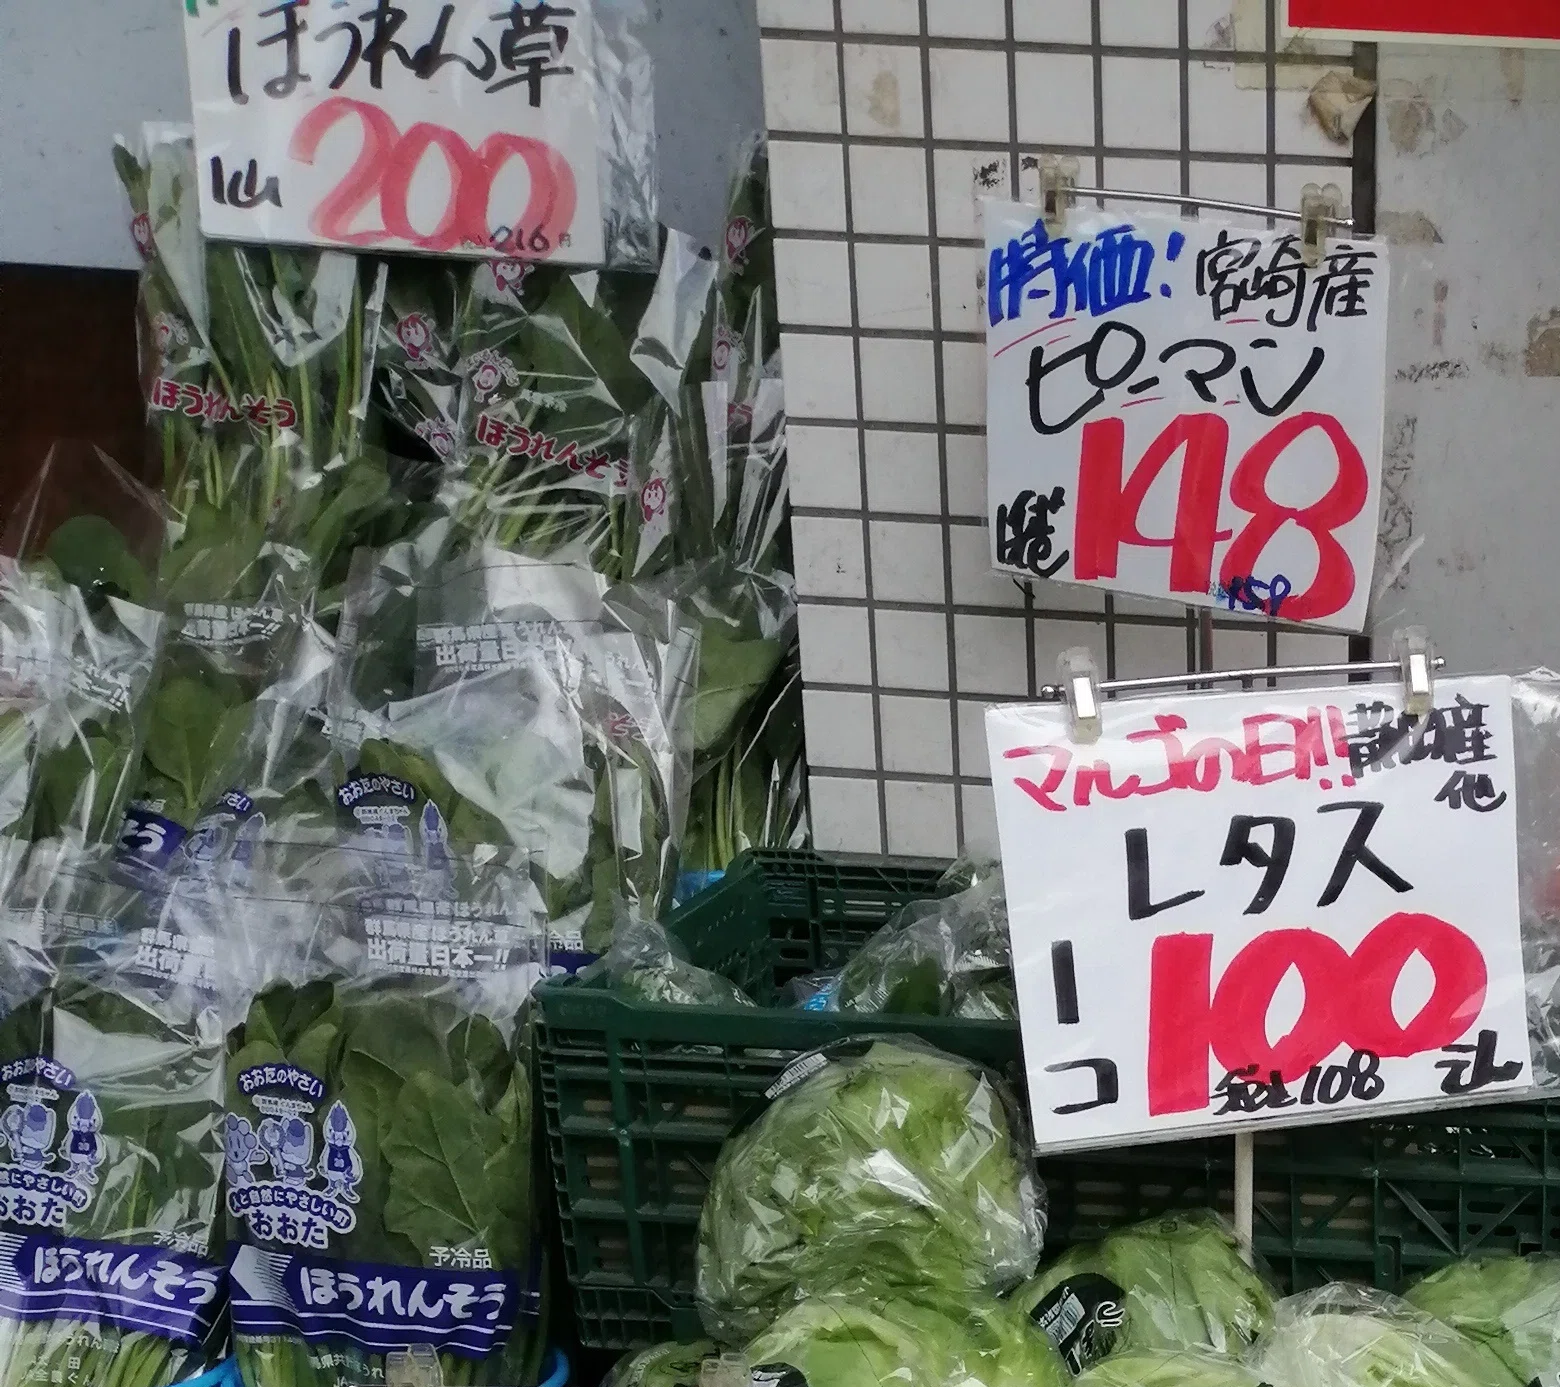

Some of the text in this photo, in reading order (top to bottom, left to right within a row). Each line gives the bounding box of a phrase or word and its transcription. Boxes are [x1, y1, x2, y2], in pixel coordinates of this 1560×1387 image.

[228, 0, 576, 107] ほうれん草
[288, 96, 577, 258] 200
[1197, 229, 1378, 333] 宮崎産
[152, 376, 298, 428] ほうれんそう
[1026, 320, 1326, 436] ピーマン
[1075, 411, 1369, 622] 148
[1125, 800, 1413, 920] レタス
[1148, 912, 1487, 1117] 100
[239, 1066, 324, 1098] おおたのやさい
[33, 1245, 219, 1306] ほうれんそう
[251, 1208, 326, 1247] おおた
[429, 1246, 493, 1269] 予冷品
[300, 1267, 507, 1321] ほうれんそう
